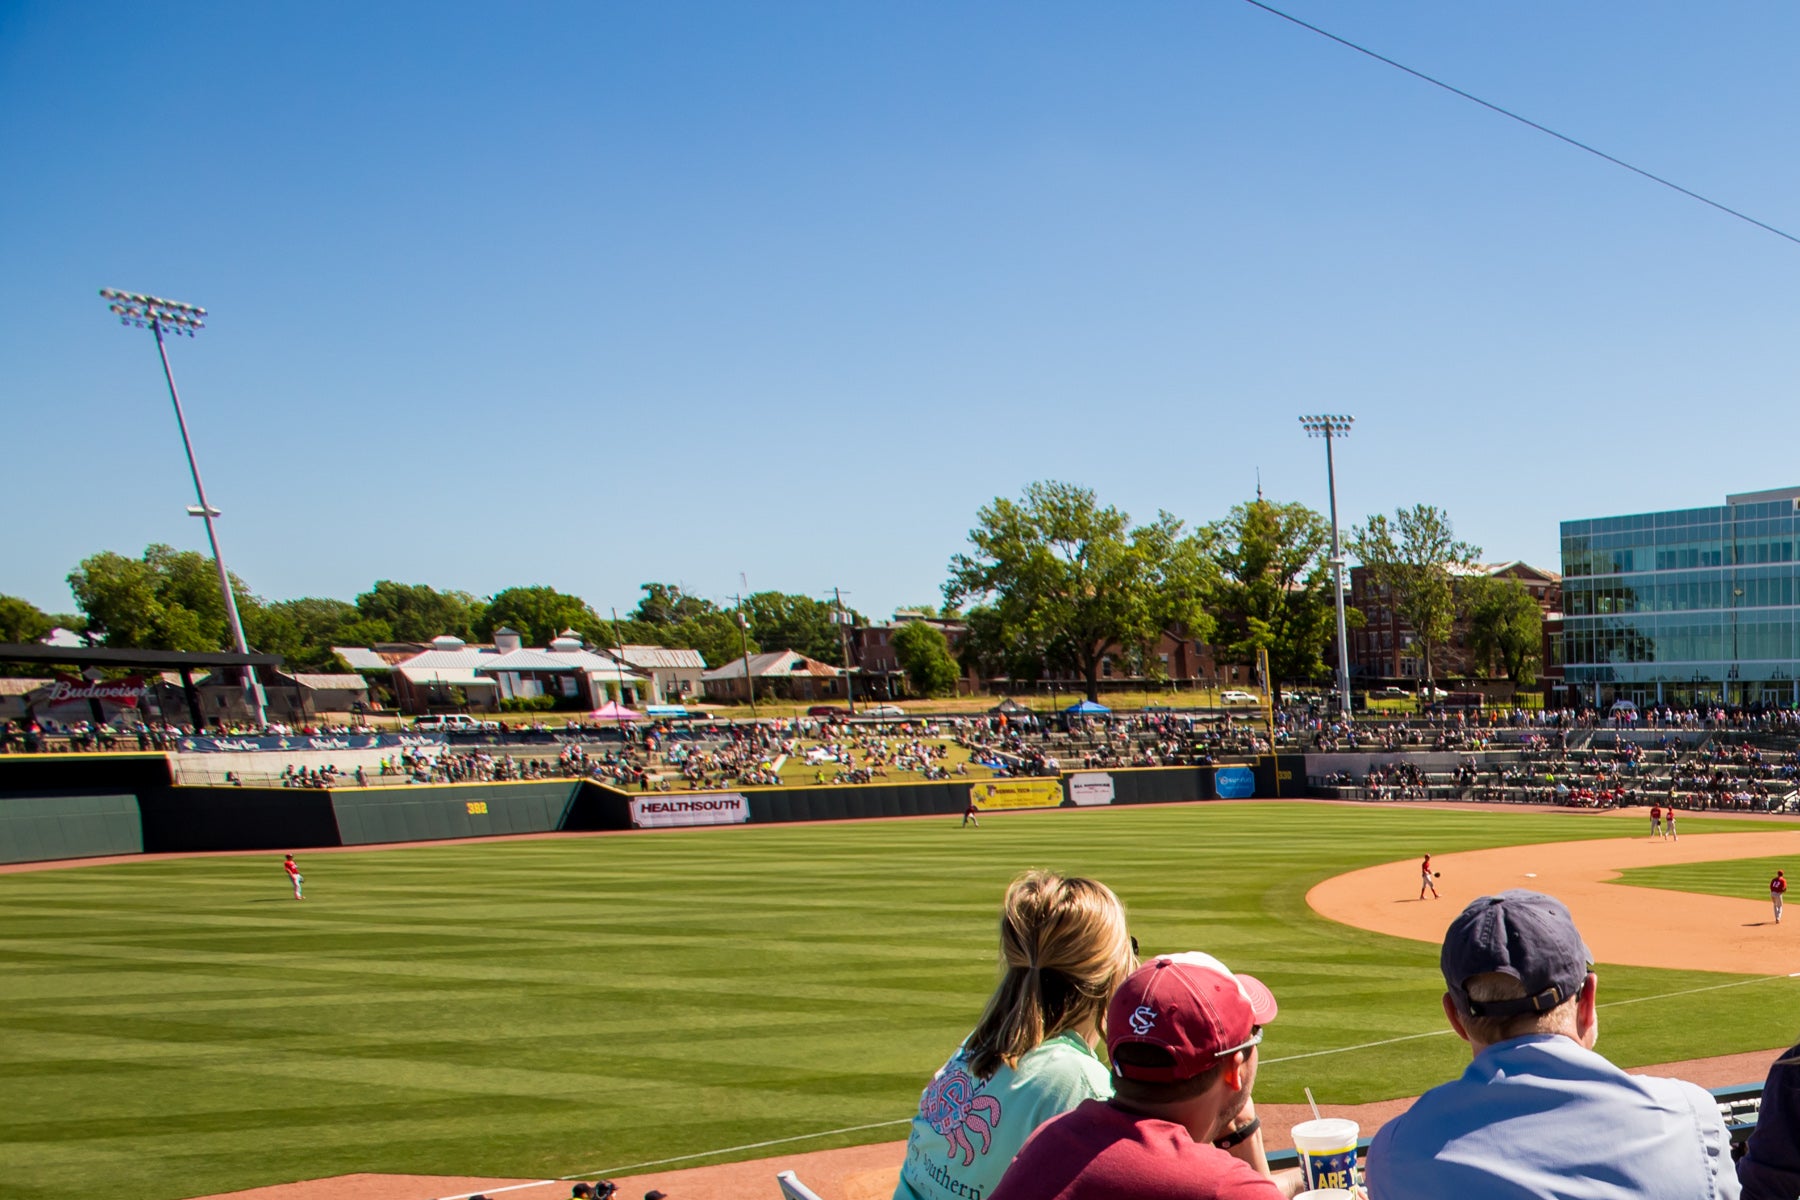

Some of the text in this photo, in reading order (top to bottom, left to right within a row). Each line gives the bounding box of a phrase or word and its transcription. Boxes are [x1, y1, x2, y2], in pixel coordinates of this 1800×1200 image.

[44, 681, 154, 700] Budweiser
[641, 800, 740, 813] HEALTHSOUTH
[1318, 1169, 1348, 1190] ARE
